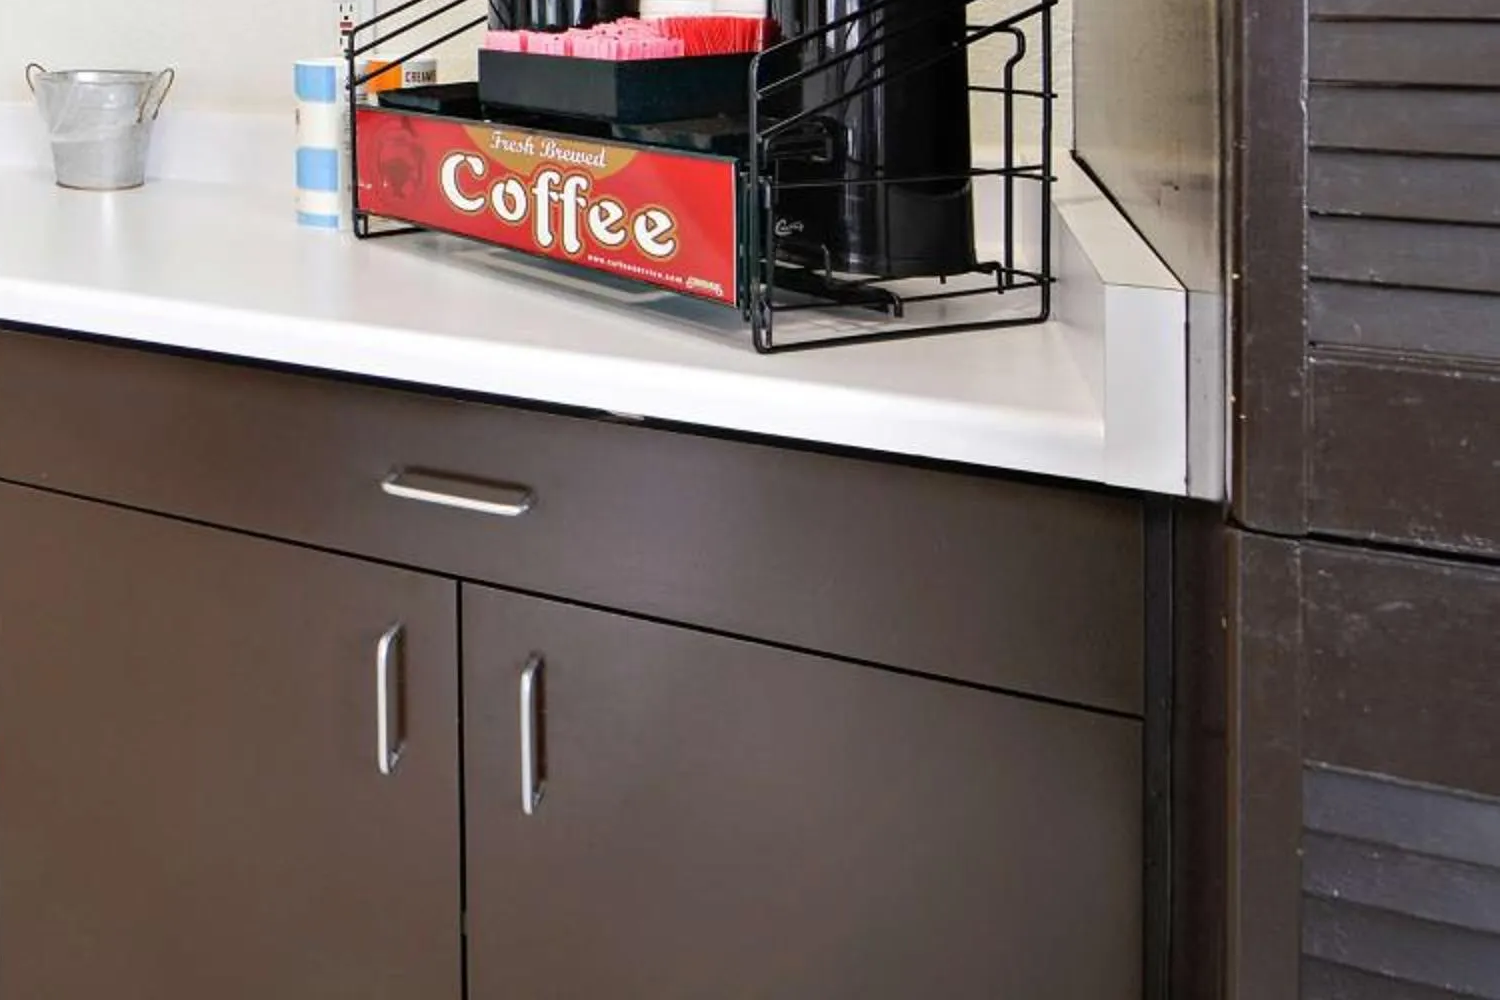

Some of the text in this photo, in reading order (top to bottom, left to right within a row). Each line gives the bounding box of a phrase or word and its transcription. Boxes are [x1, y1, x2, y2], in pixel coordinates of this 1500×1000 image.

[489, 130, 609, 169] Fresh Brewed
[440, 150, 678, 259] Coffee
